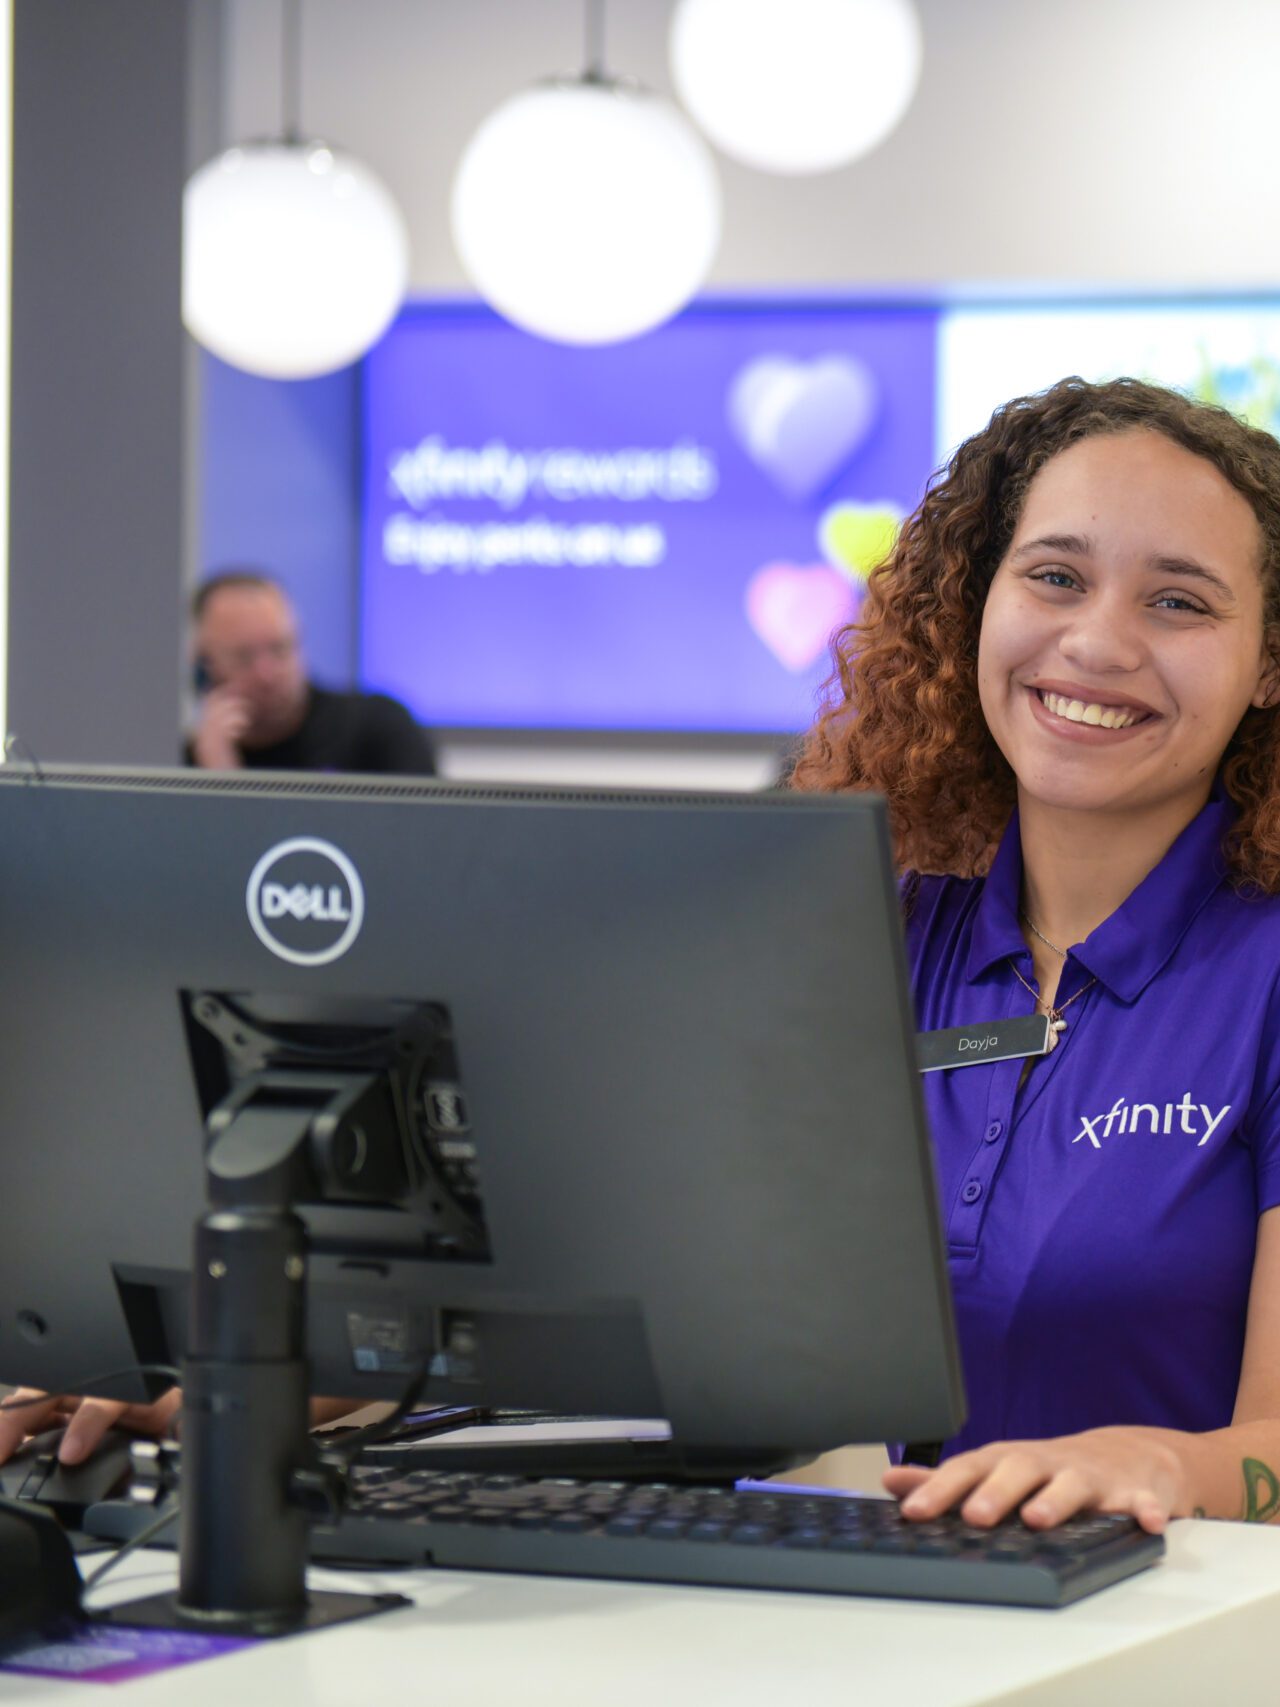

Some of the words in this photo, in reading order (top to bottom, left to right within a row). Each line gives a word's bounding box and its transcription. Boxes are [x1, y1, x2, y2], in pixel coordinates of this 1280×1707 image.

[389, 435, 529, 511] xfinity
[532, 437, 717, 501] rewards
[261, 882, 351, 921] DELL
[958, 1035, 999, 1052] Dayja
[1072, 1092, 1232, 1148] xfinity
